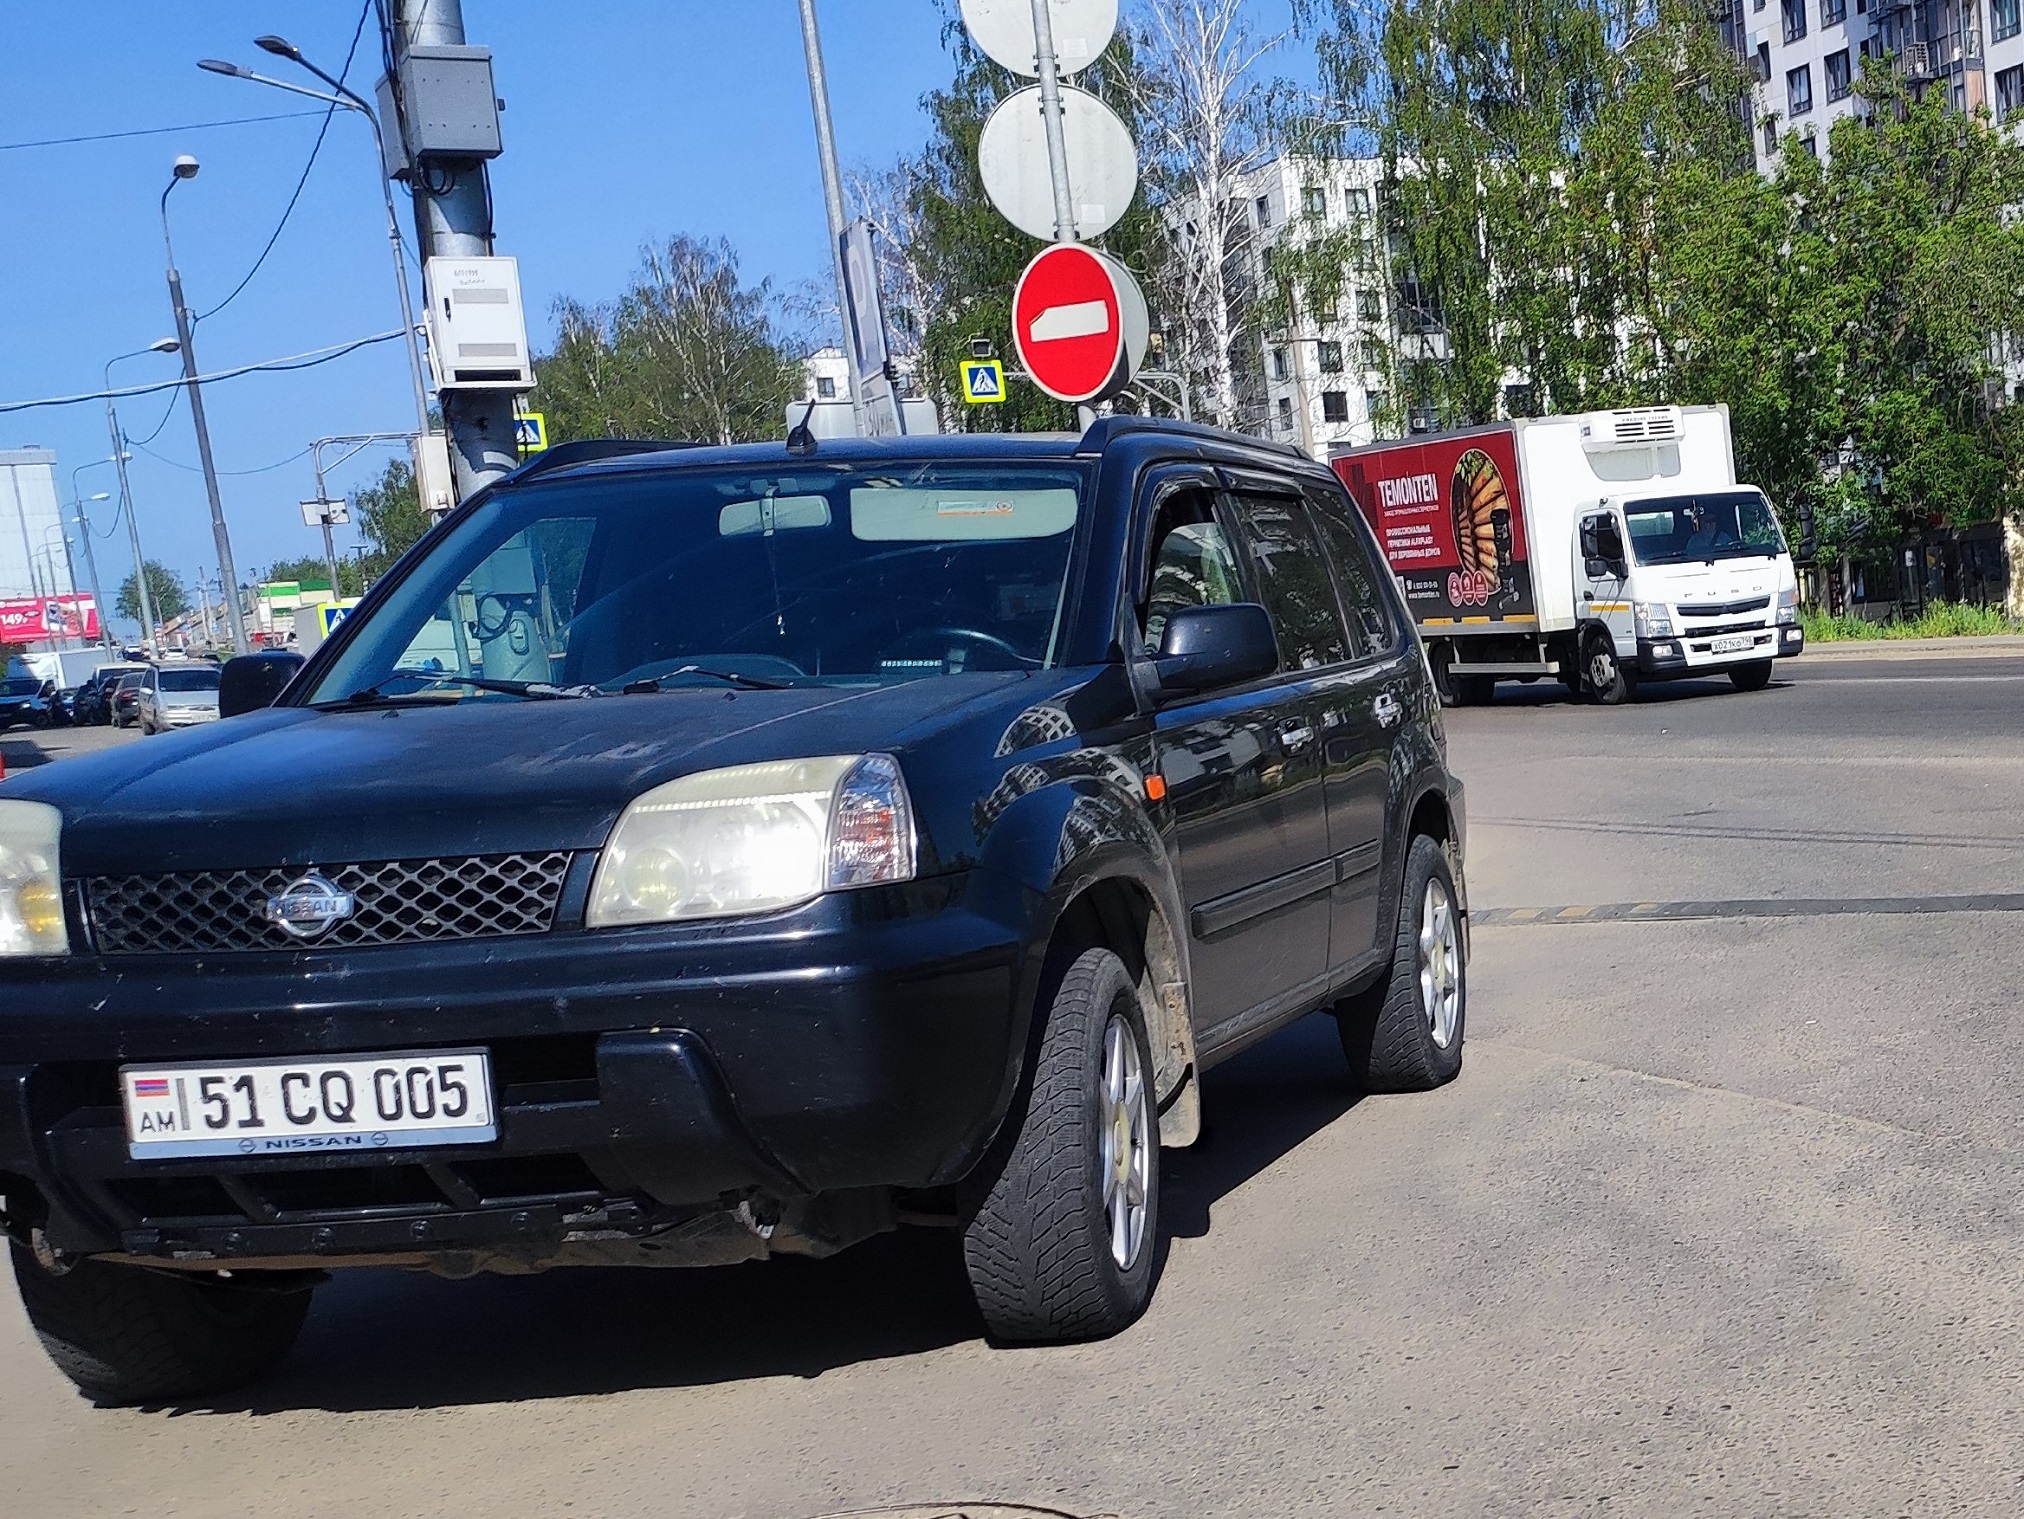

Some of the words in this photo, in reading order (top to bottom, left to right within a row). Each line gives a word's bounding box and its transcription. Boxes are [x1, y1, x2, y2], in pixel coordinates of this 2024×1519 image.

[1378, 473, 1438, 507] TEMONTEN
[199, 1073, 265, 1129] 51
[280, 1070, 357, 1125] CQ
[374, 1064, 468, 1121] 005
[140, 1111, 176, 1134] AM
[265, 1134, 362, 1150] NISSAN
